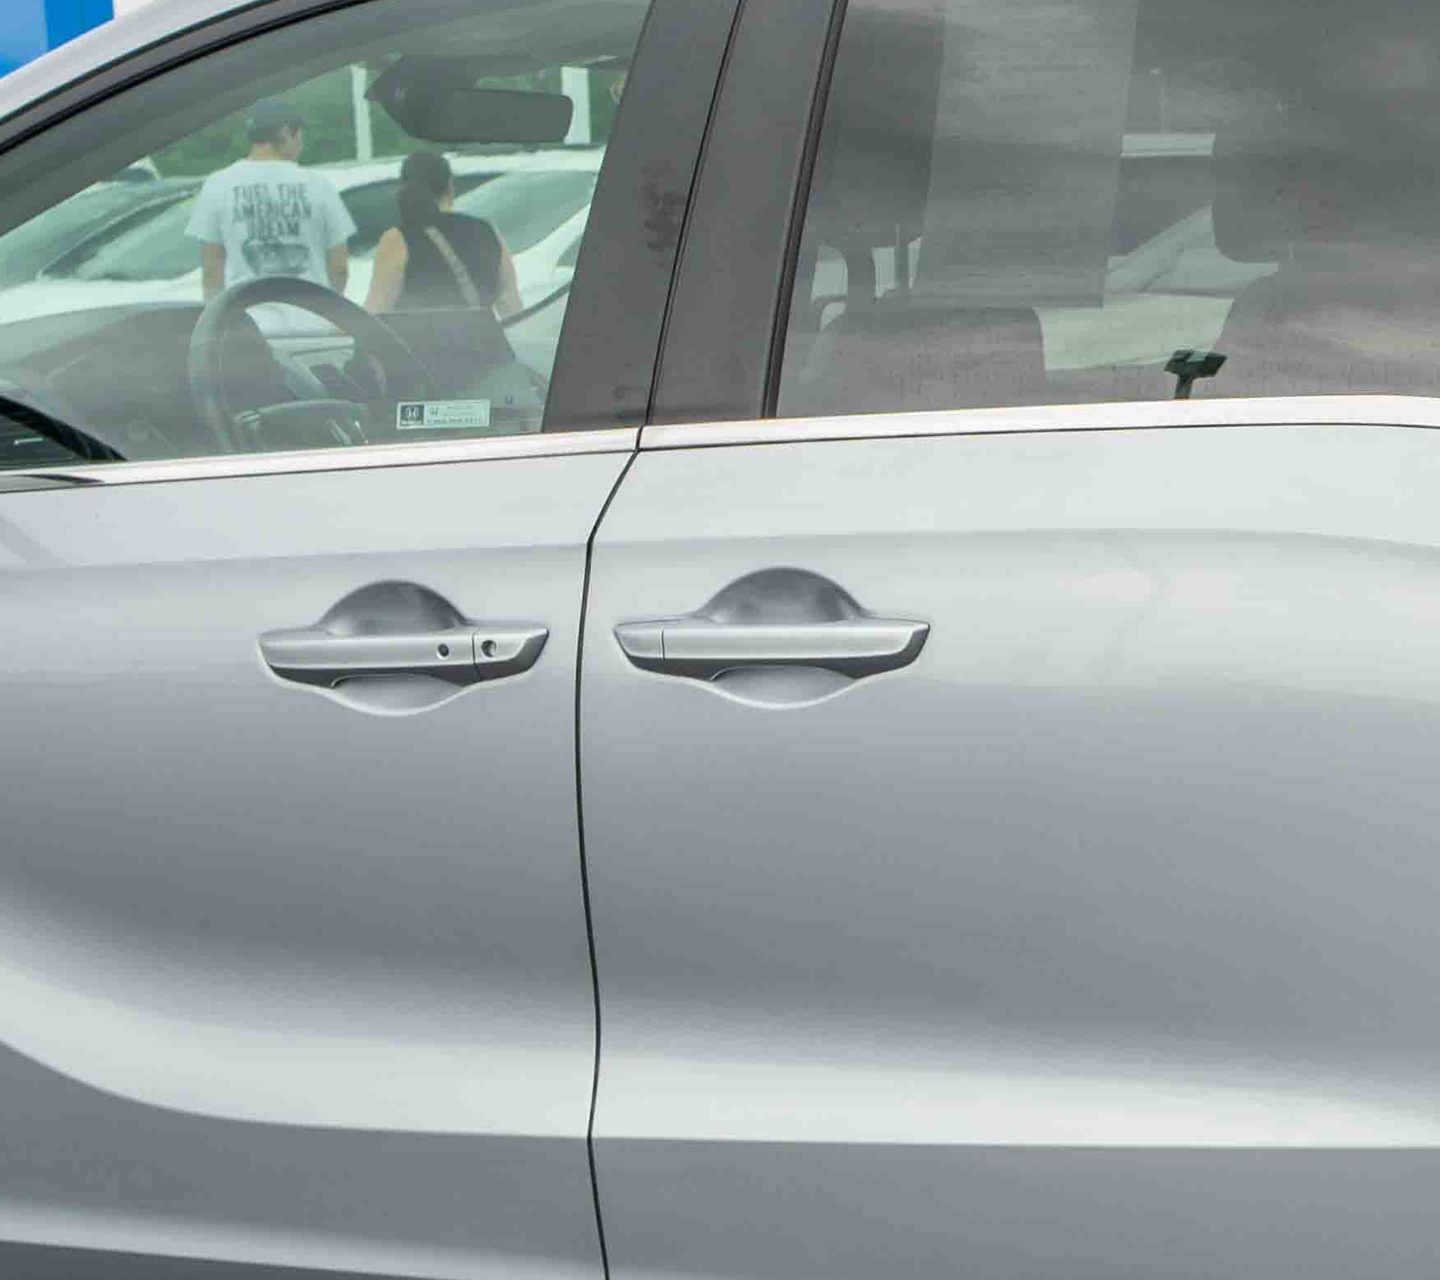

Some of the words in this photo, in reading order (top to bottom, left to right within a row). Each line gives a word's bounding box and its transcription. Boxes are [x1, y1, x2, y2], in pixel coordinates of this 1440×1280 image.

[232, 183, 269, 202] FUEL
[276, 182, 309, 201] THE
[231, 199, 312, 223] AMERICAN
[247, 219, 300, 240] DREAM
